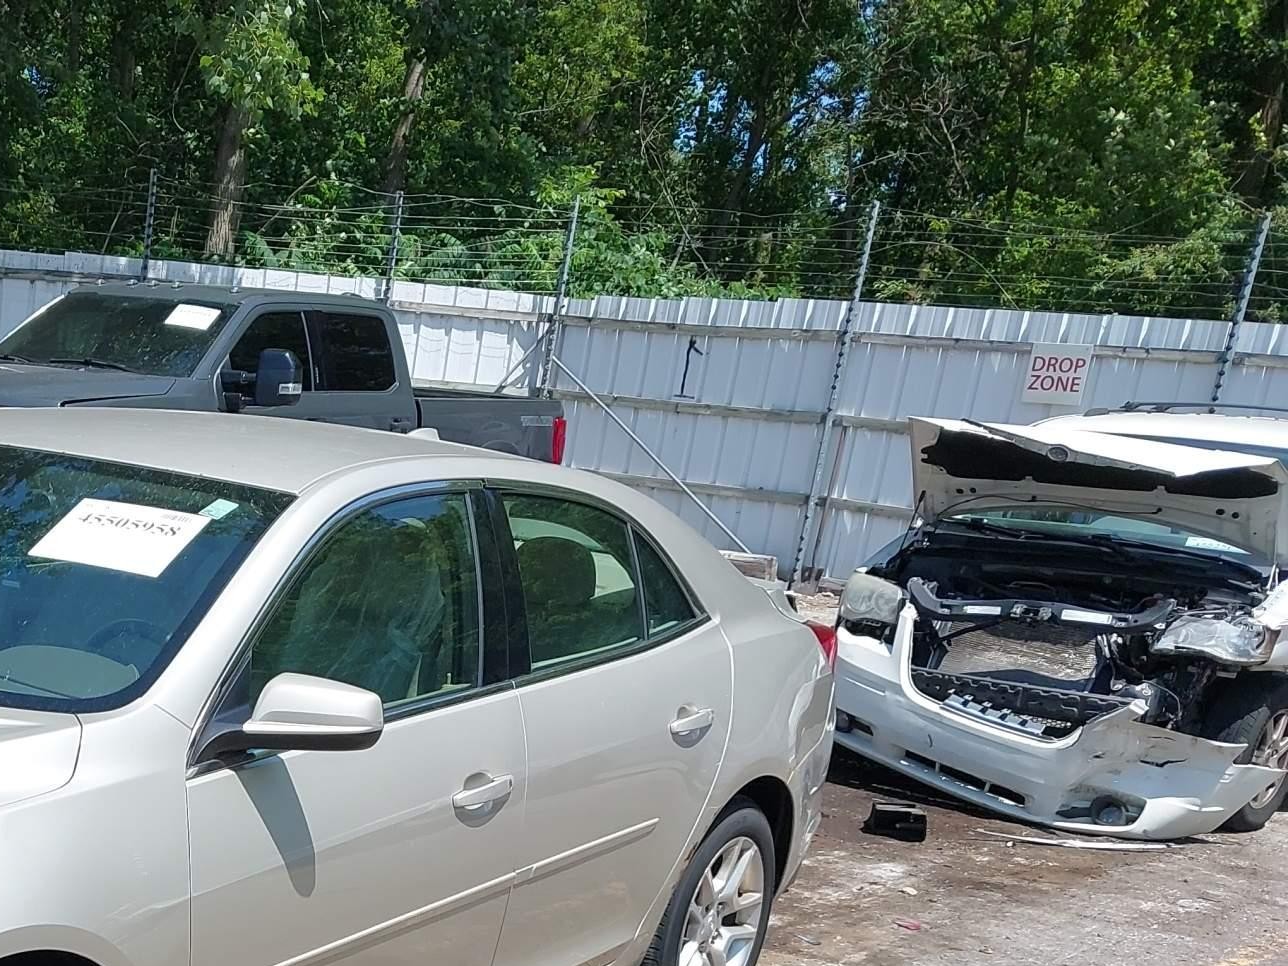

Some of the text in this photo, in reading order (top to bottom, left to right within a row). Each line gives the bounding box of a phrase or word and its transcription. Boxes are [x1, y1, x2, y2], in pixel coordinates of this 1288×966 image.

[1031, 356, 1086, 373] DROP
[1027, 375, 1081, 392] ZONE
[78, 513, 181, 536] 45505958
